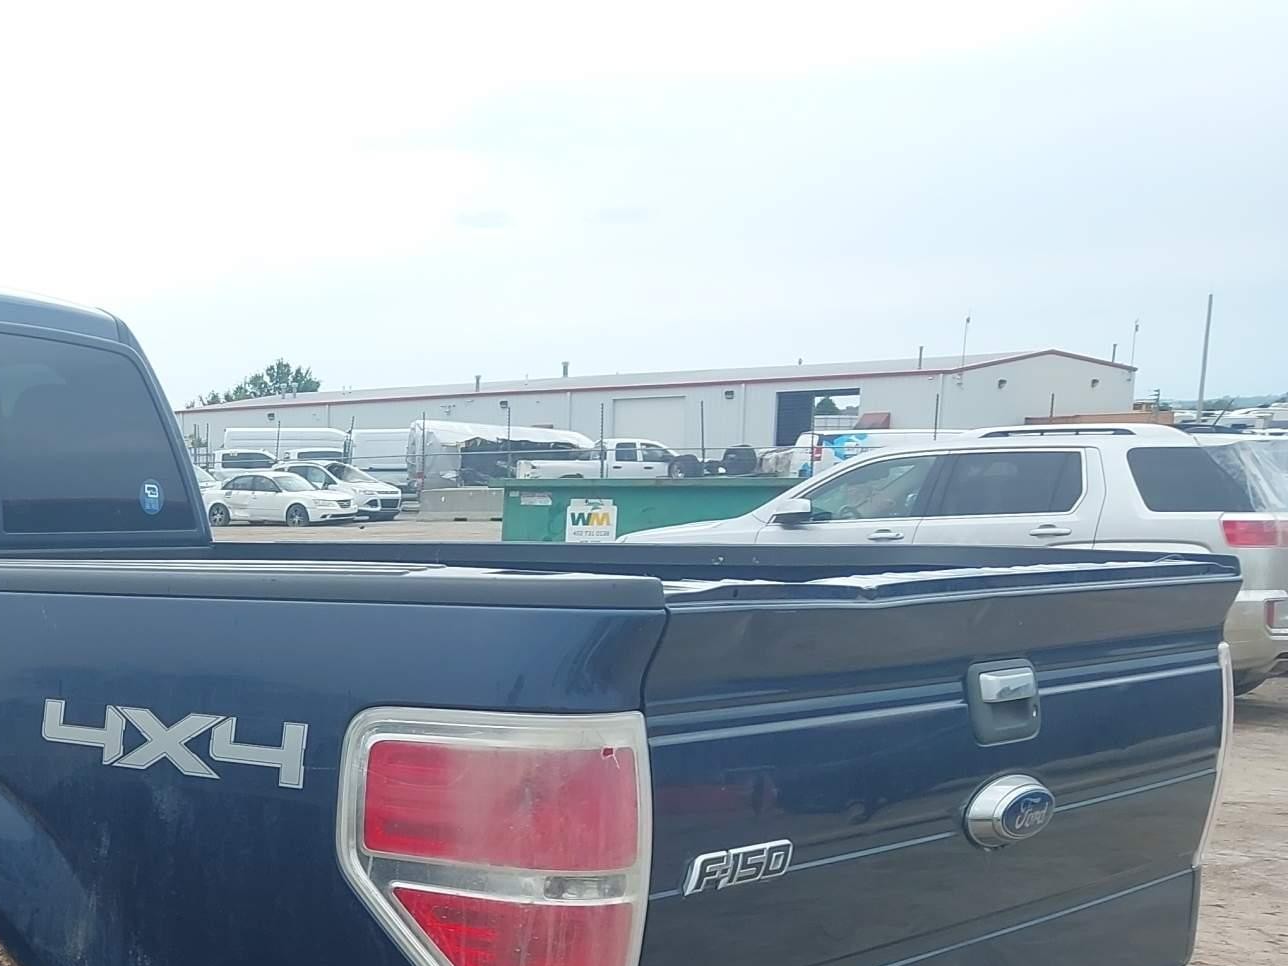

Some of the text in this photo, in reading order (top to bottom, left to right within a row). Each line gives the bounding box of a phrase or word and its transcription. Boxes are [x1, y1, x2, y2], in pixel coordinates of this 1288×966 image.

[570, 511, 611, 527] WM
[1014, 796, 1050, 830] Ford
[683, 838, 794, 897] F-150
